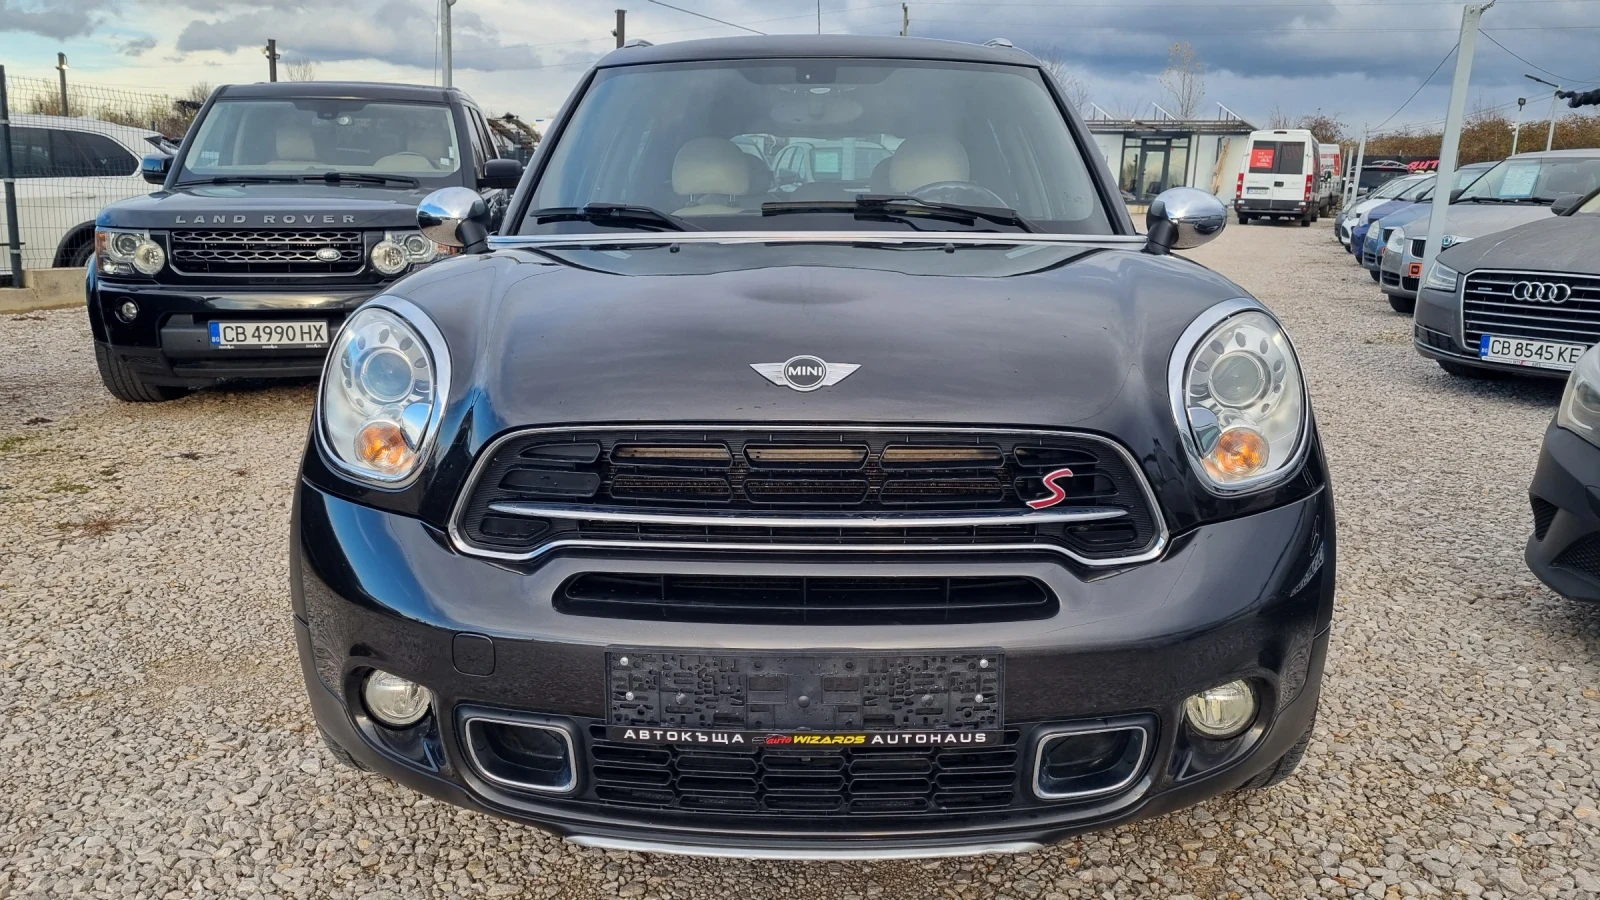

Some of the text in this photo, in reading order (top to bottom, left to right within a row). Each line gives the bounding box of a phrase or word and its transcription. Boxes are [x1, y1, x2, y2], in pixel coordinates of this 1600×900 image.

[175, 214, 355, 224] LAND ROVER
[222, 324, 325, 343] CB 4990 HX
[1491, 339, 1511, 356] CB
[1514, 342, 1555, 361] 8545
[1557, 346, 1582, 364] KE
[788, 366, 823, 376] MINI
[1026, 468, 1074, 510] S
[623, 729, 745, 745] АВТОКЪЩА
[793, 735, 867, 745] WIZARDS
[871, 732, 987, 745] AUTOHAUS
